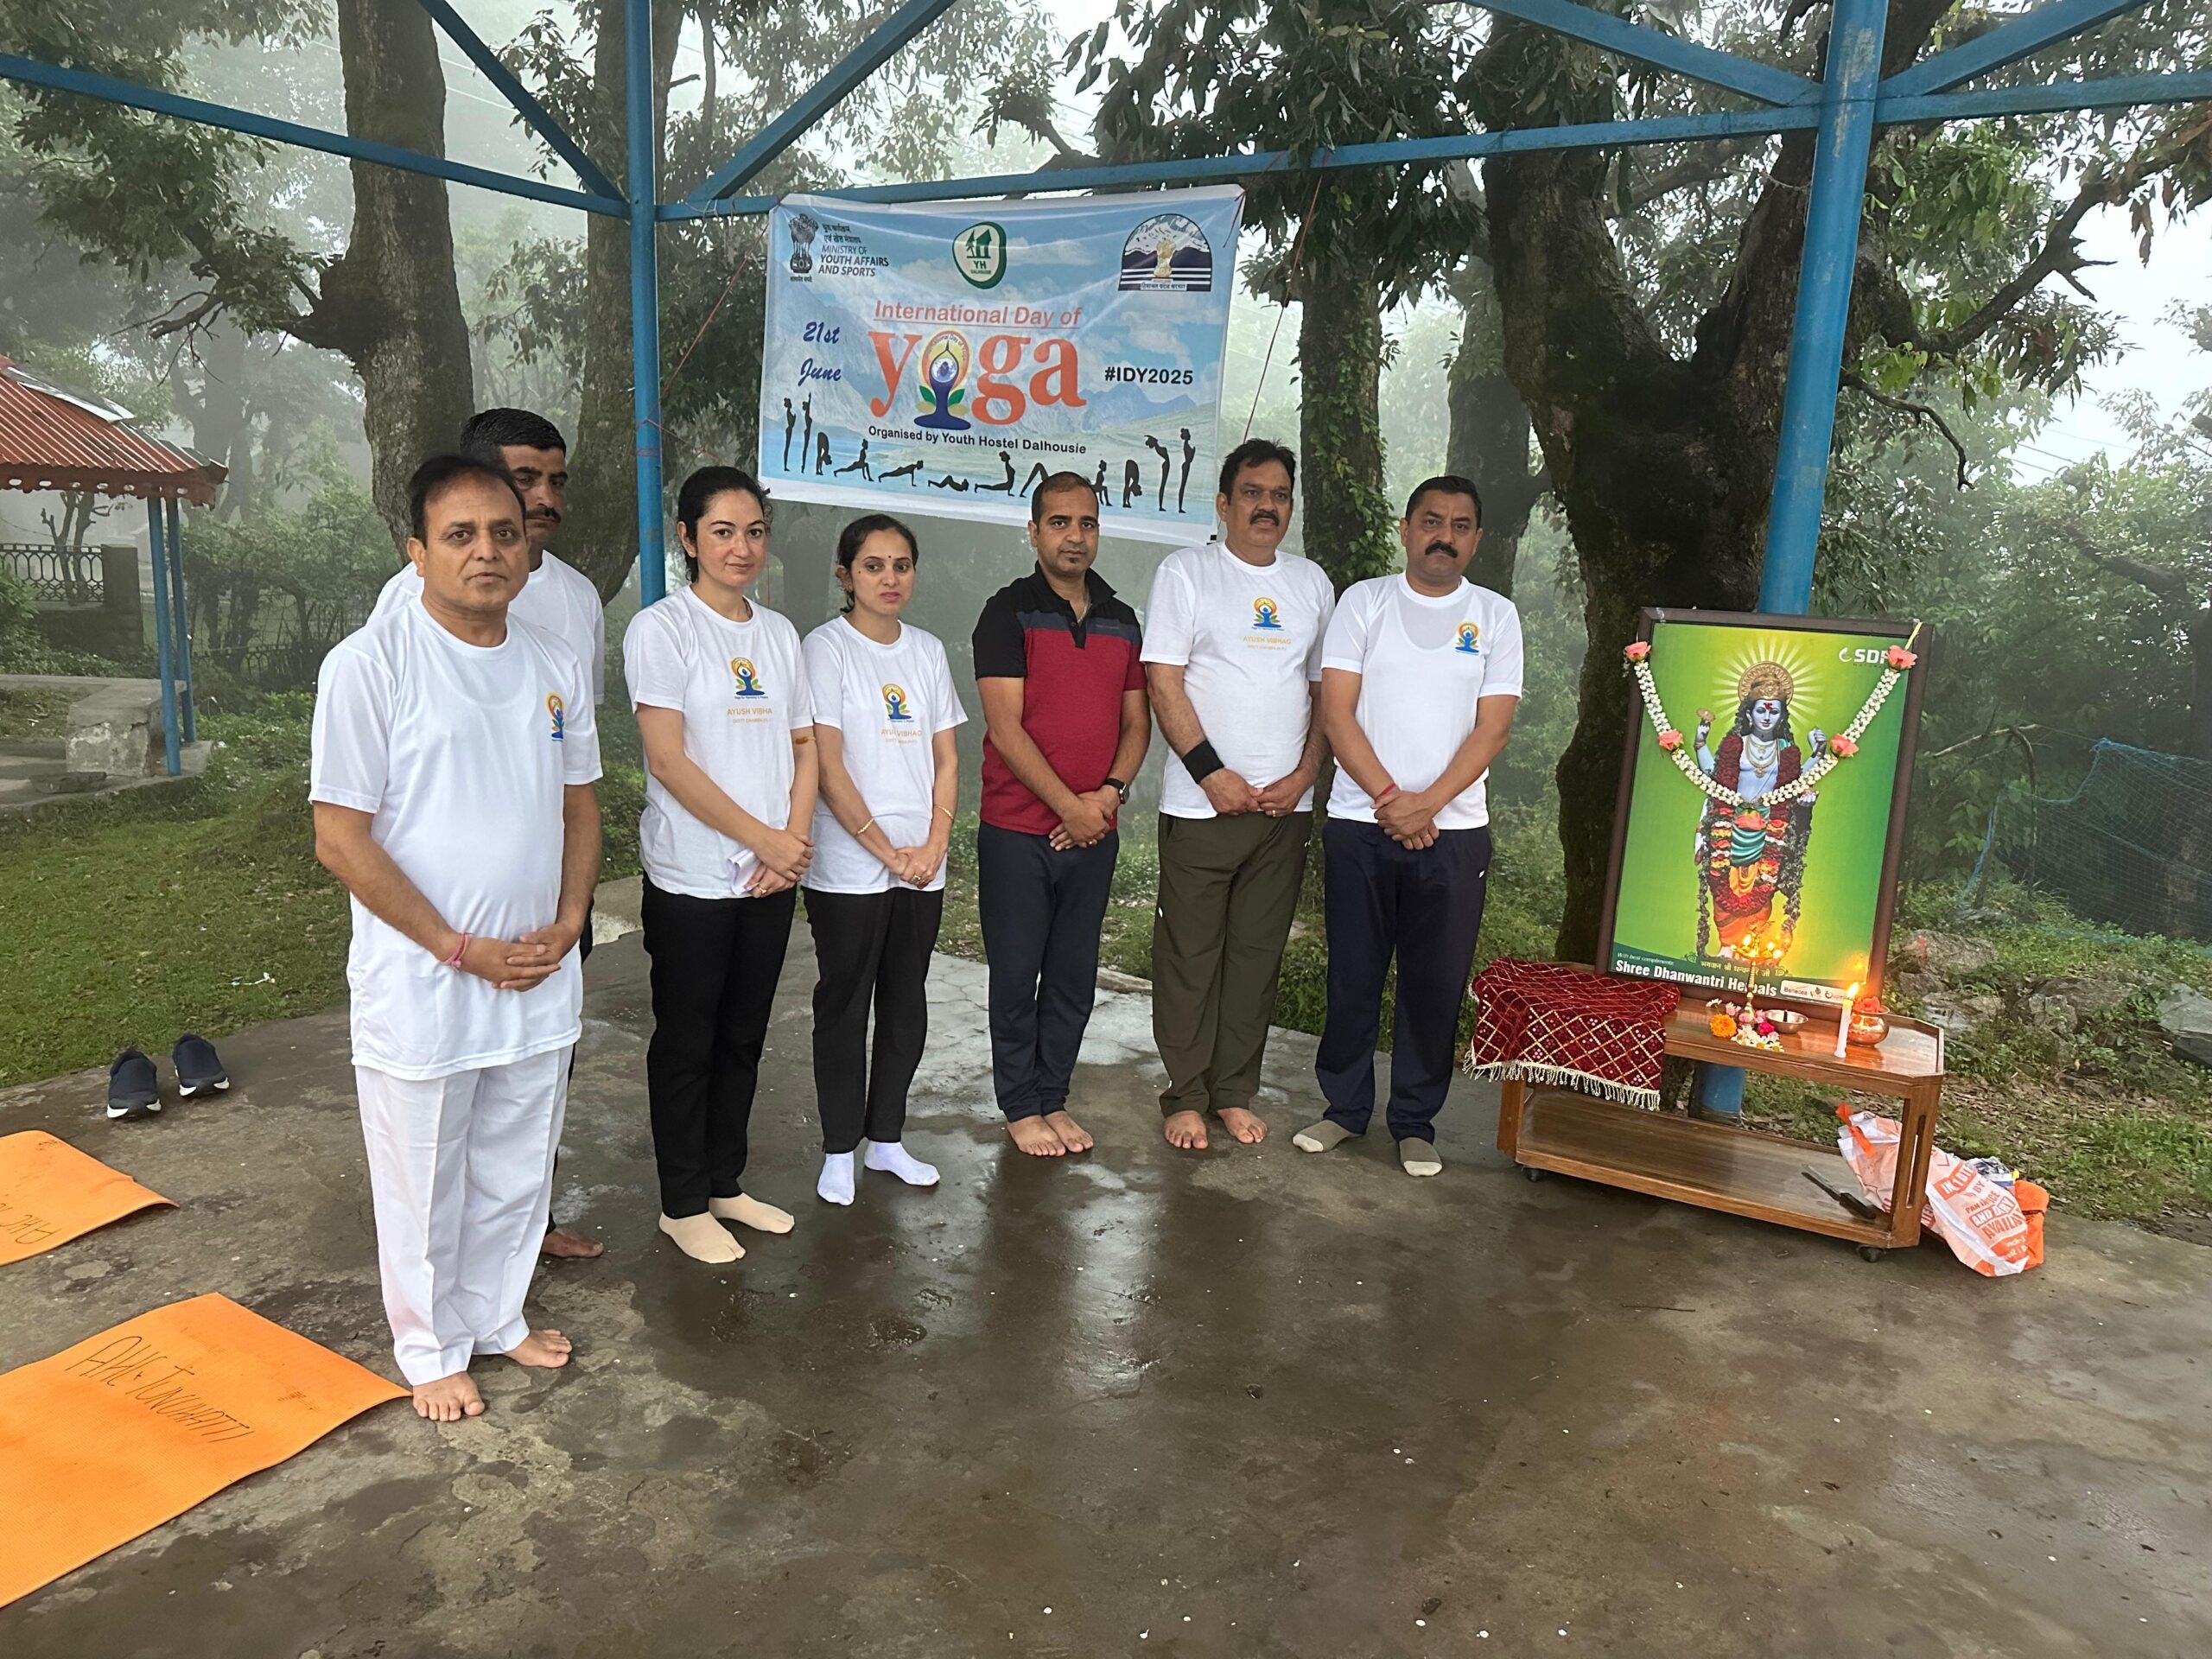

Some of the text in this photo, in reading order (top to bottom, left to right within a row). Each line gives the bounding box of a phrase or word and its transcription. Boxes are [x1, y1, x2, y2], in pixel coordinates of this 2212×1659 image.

[822, 245, 868, 255] MINISTRY OF
[820, 255, 889, 267] YOUTH AFFAIRS
[973, 260, 987, 269] YH
[818, 265, 875, 276] AND SPORTS
[874, 301, 1082, 328] International Day of
[803, 321, 840, 344] 21st
[798, 358, 842, 387] June
[1104, 366, 1193, 385] #IDY2025
[868, 425, 1087, 454] Organised by Youth Hostel Dalhousie
[1615, 959, 1650, 976] Shree
[1653, 965, 1725, 988] Dhanwantri
[1973, 1180, 1986, 1193] BY
[1965, 1203, 1980, 1214] PAN
[1970, 1210, 1993, 1225] AND
[65, 1336, 168, 1387] AHC
